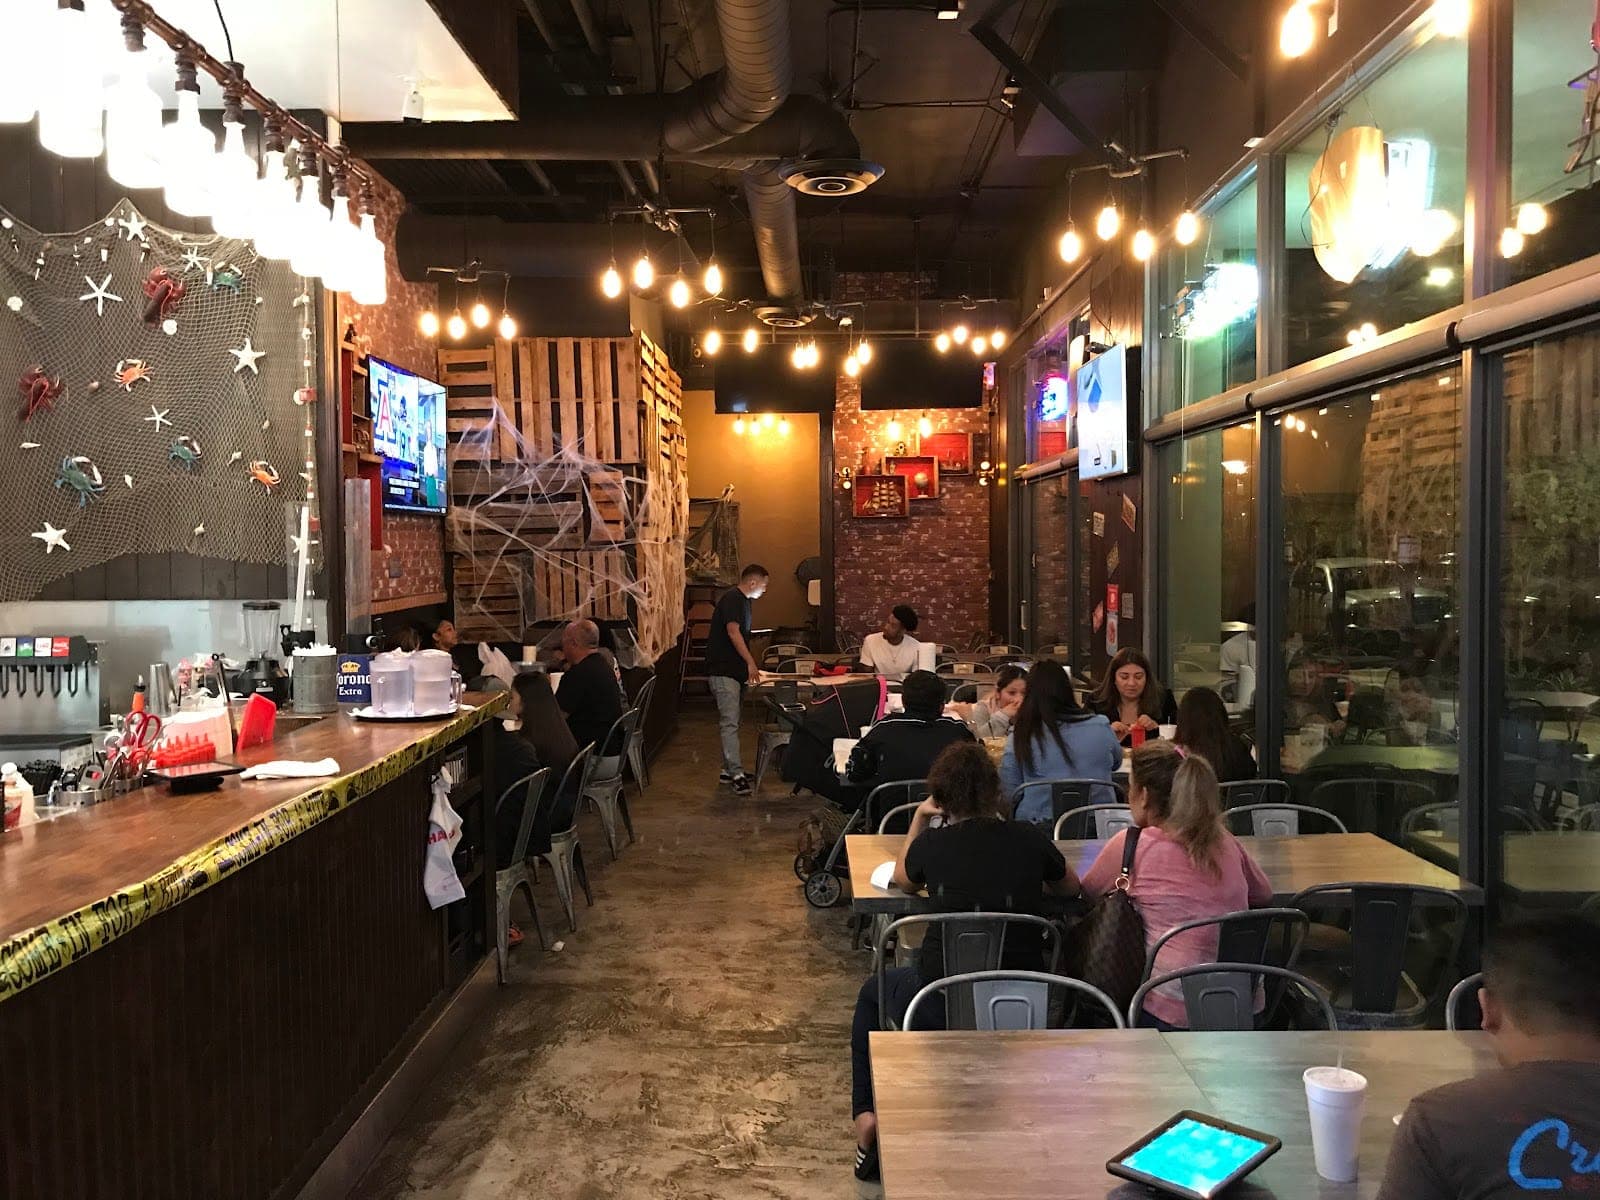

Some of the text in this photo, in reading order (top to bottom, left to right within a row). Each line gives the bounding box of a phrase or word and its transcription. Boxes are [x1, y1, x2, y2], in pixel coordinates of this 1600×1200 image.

[339, 687, 362, 696] Extra
[58, 911, 91, 961] IN
[91, 893, 133, 945] FOR
[1508, 1118, 1600, 1190] Cr
